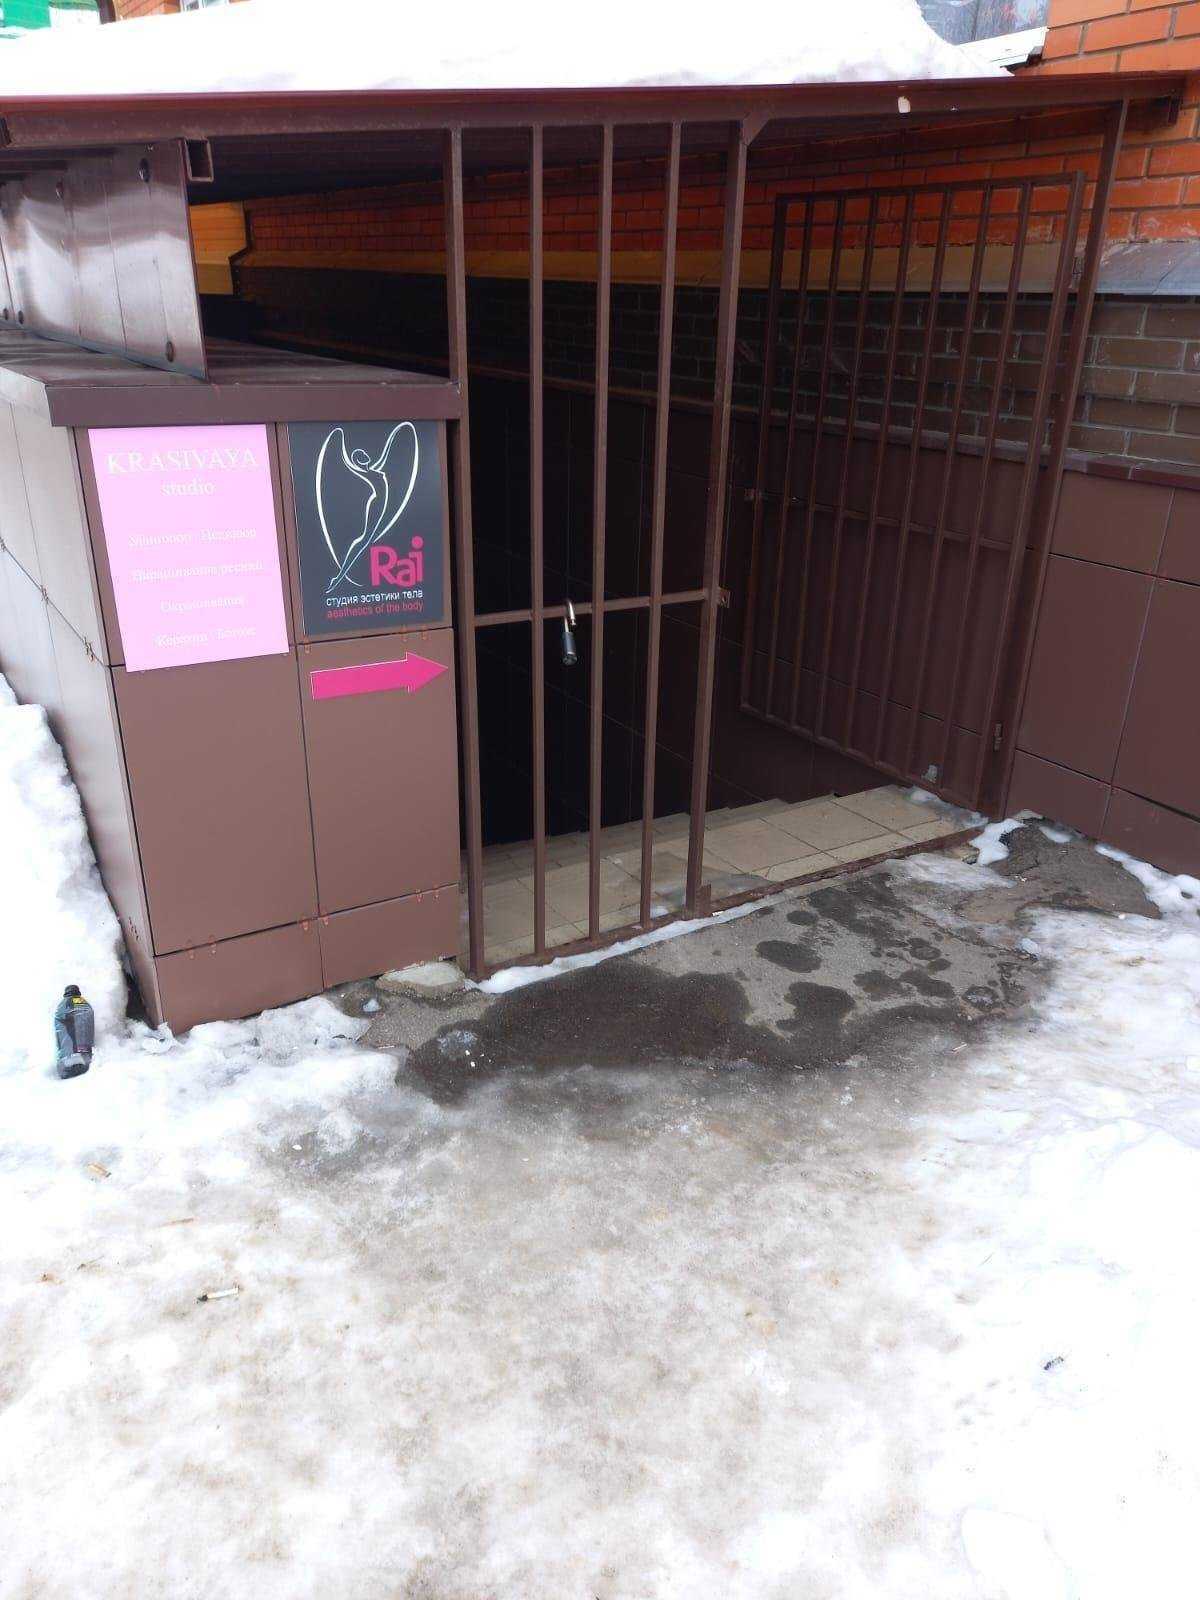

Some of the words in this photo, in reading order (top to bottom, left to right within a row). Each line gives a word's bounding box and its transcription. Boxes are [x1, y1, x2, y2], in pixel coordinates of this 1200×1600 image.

[106, 448, 259, 474] KRASIVAYA
[161, 476, 216, 496] studio
[370, 536, 424, 588] Rai
[326, 595, 358, 608] студия
[360, 592, 400, 603] эстетики
[402, 589, 424, 599] тела
[327, 605, 372, 619] aesthetics
[375, 603, 384, 614] of
[386, 602, 400, 613] the
[402, 600, 424, 614] body
